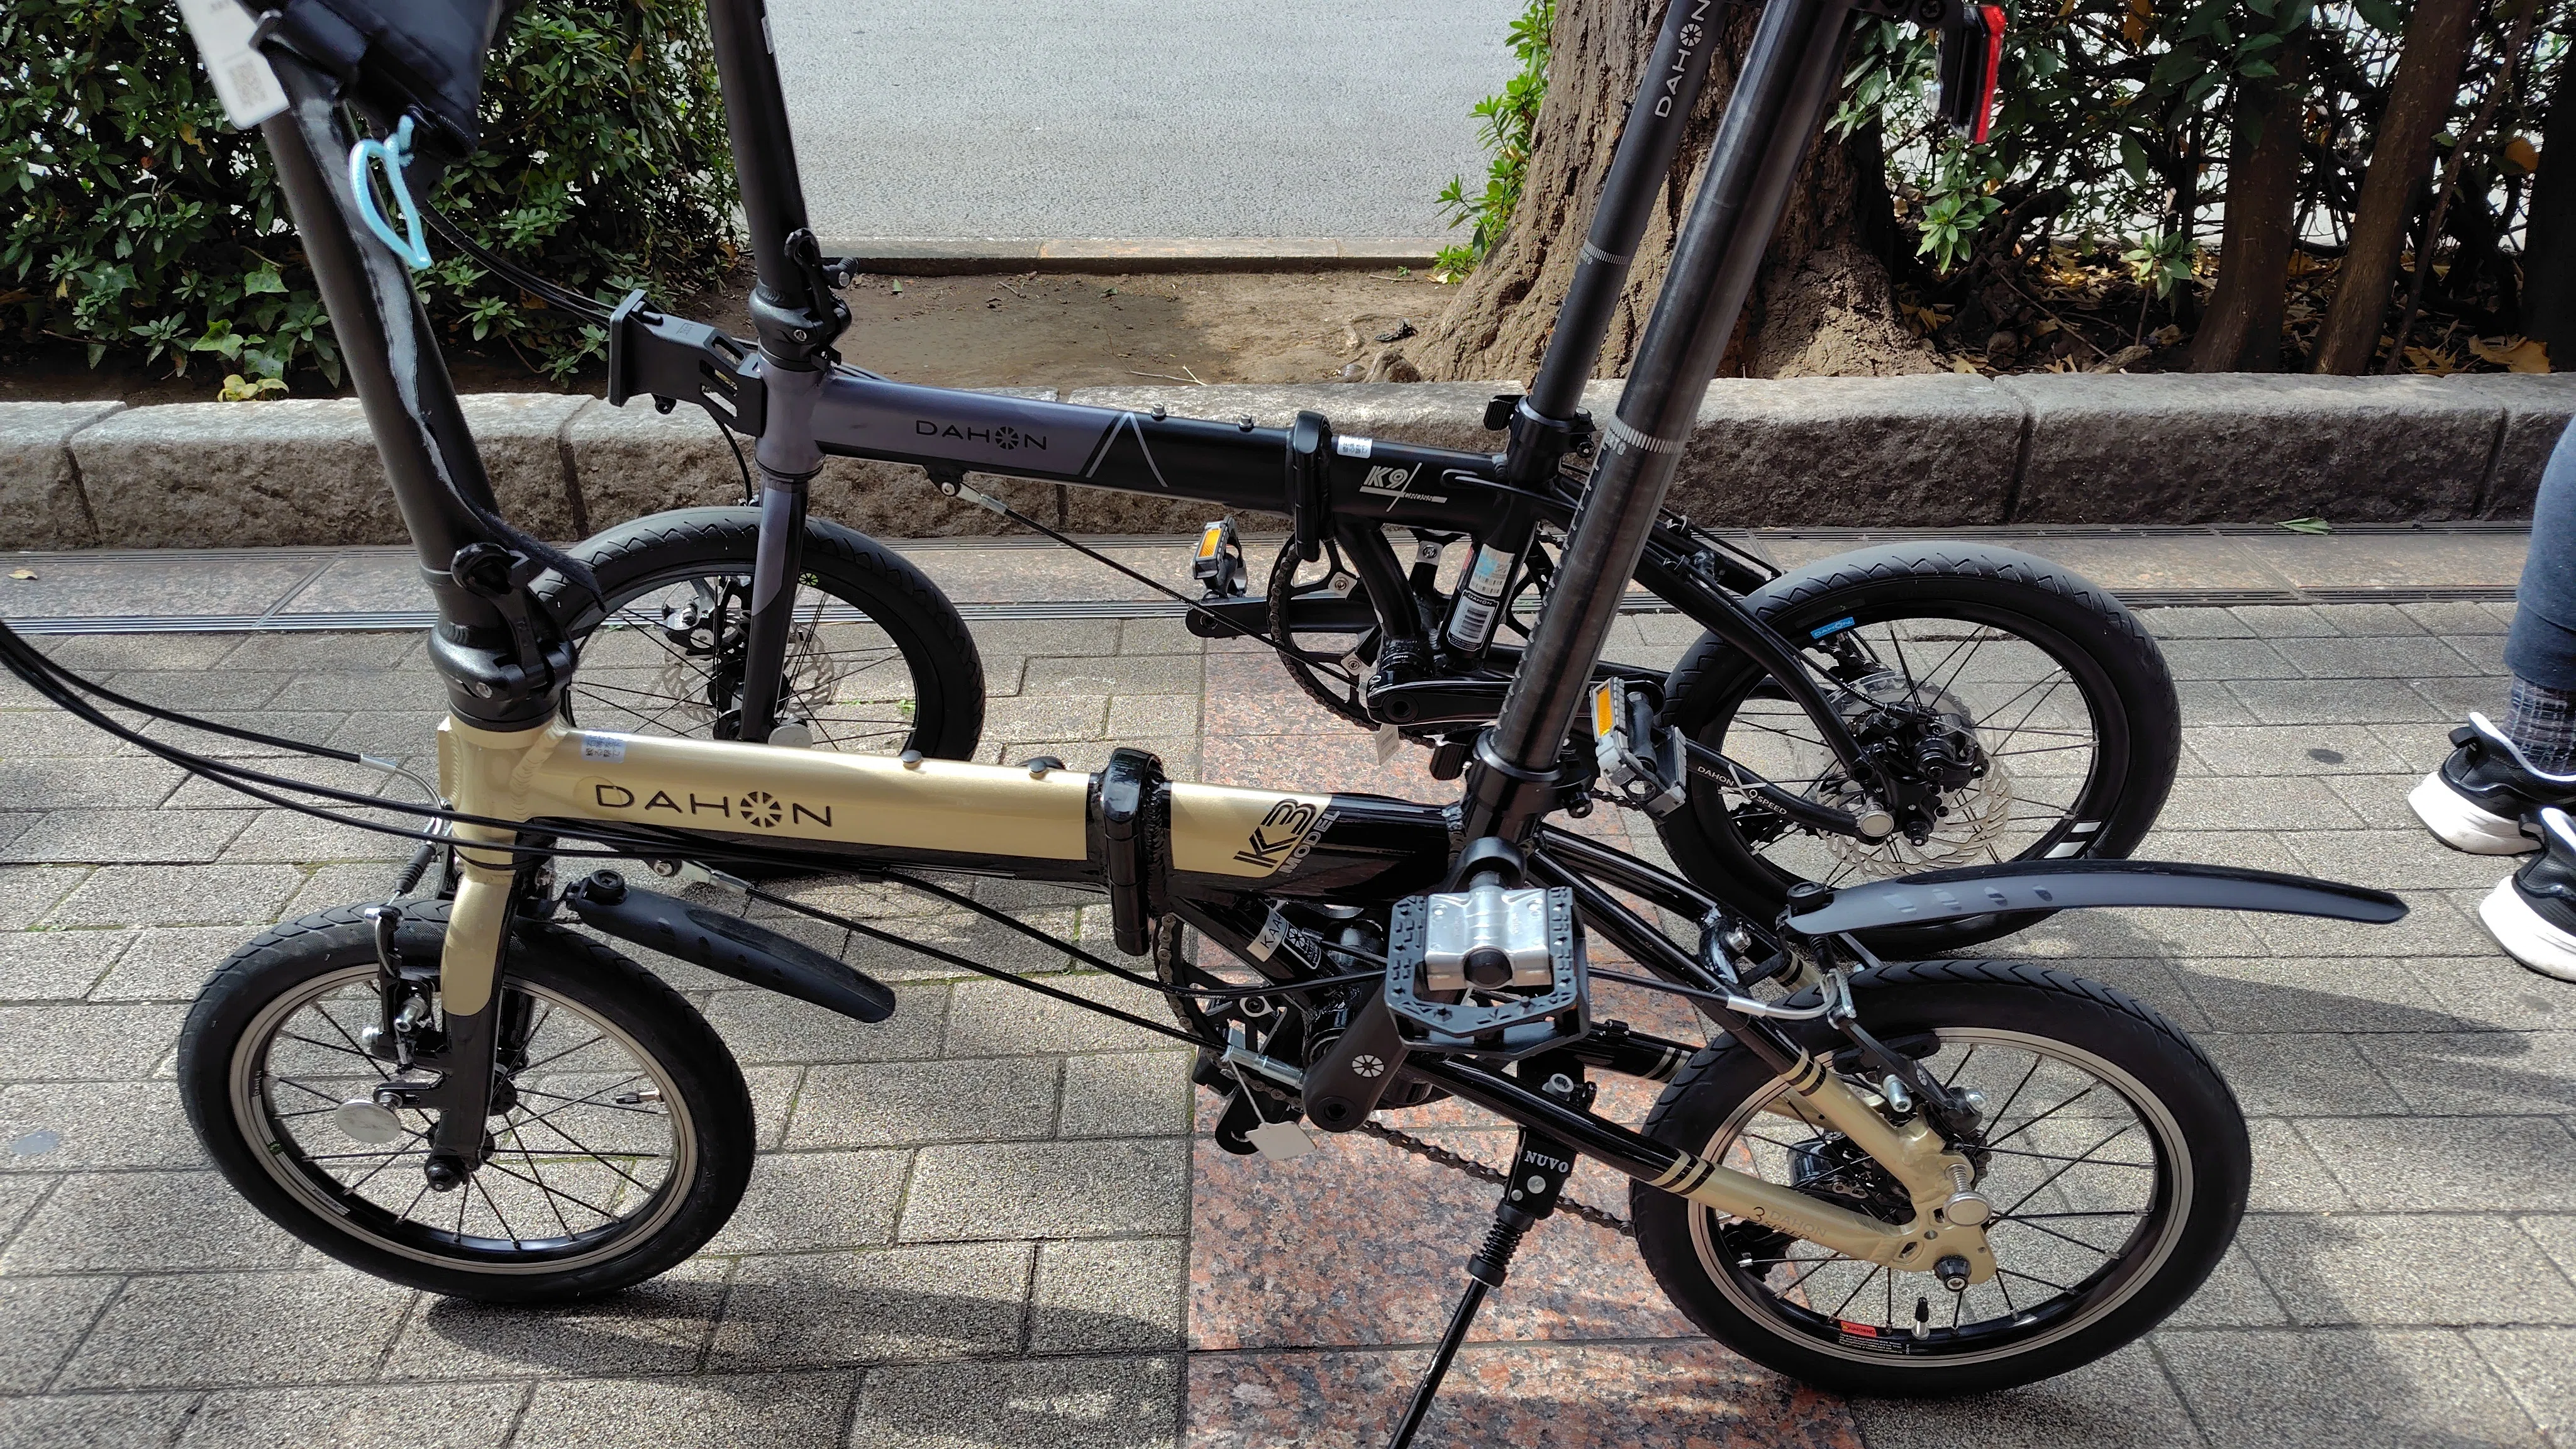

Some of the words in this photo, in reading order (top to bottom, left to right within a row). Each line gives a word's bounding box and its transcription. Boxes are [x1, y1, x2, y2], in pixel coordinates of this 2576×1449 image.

[1655, 0, 1711, 118] DAHON
[916, 419, 1046, 450] DAHON
[1363, 465, 1409, 489] K9
[1814, 619, 1853, 637] DAHON
[1697, 766, 1735, 787] DAHON
[595, 784, 833, 828] DAHON
[1748, 789, 1758, 799] 9
[1757, 796, 1787, 815] SPEED
[1233, 798, 1317, 869] K3
[1278, 810, 1341, 874] MODEL
[1524, 1150, 1569, 1173] NUVO
[1747, 1206, 1765, 1222] 3
[1769, 1210, 1827, 1238] DAHON
